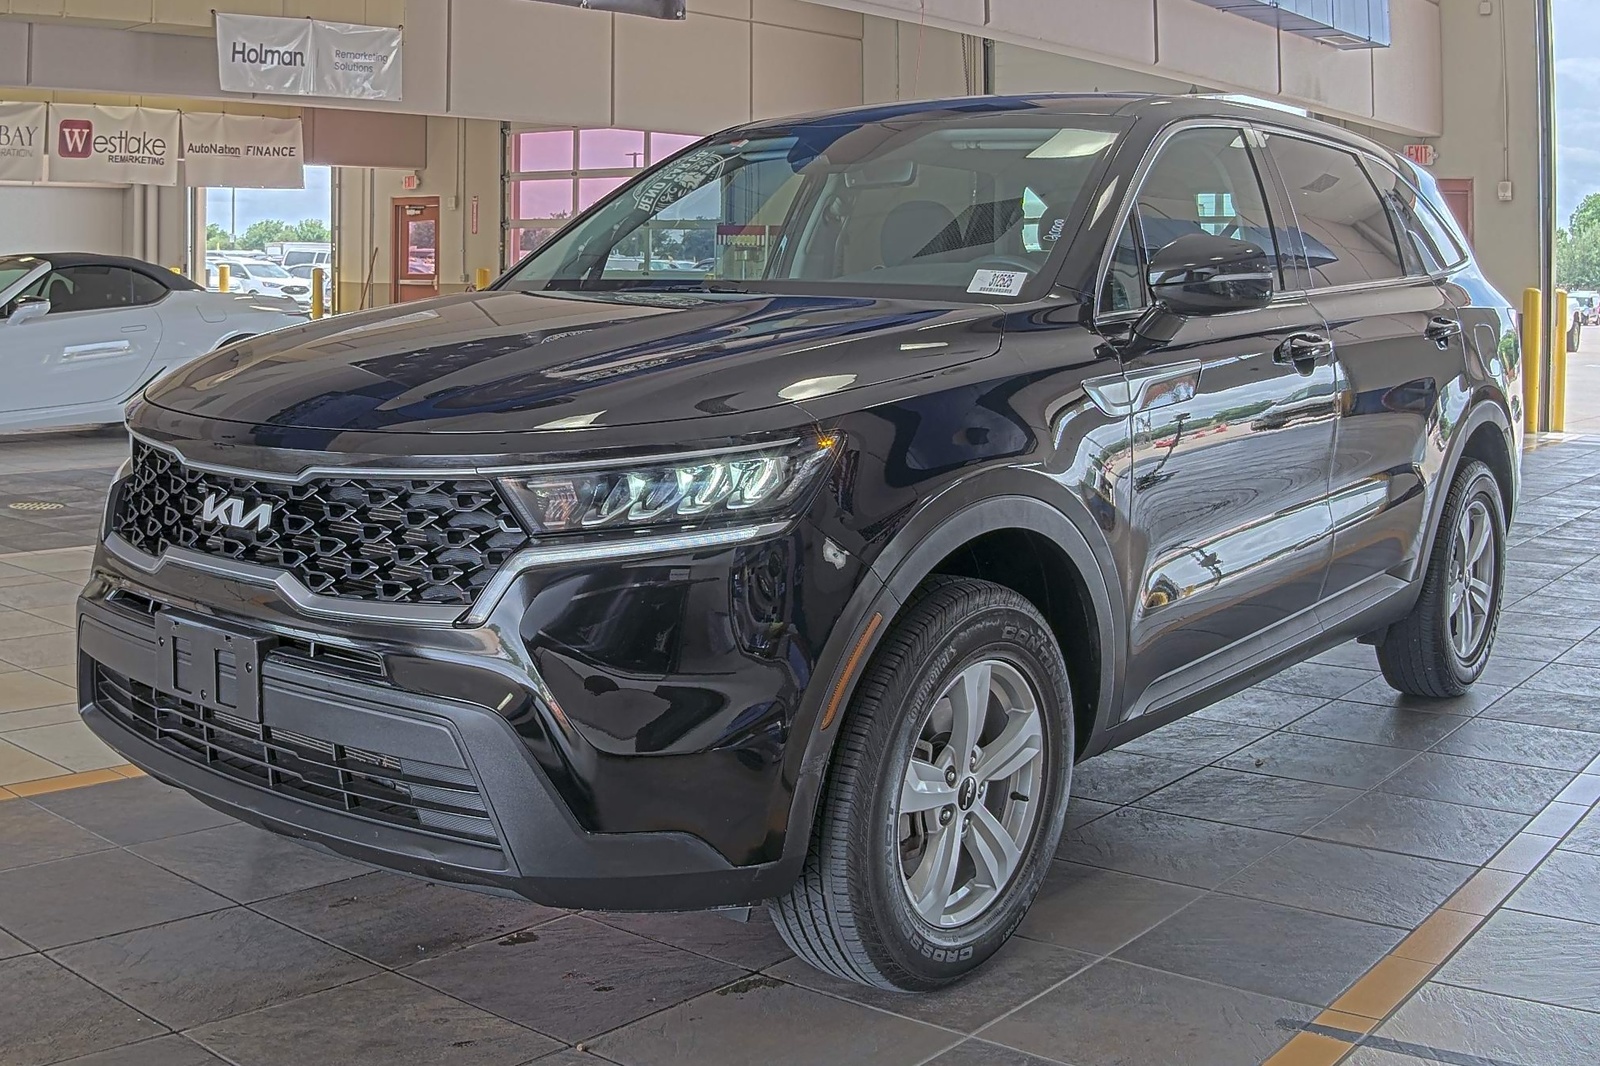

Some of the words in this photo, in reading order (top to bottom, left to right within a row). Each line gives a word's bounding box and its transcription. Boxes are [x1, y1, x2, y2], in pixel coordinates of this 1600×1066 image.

[231, 41, 305, 67] Holman
[335, 49, 389, 64] Remarketing
[334, 61, 374, 73] Solutions
[0, 124, 39, 146] BAY
[62, 127, 167, 156] Westlake
[187, 142, 241, 156] AutoNation
[246, 145, 296, 157] FINANCE
[1408, 146, 1428, 163] EXIT
[107, 154, 165, 166] REMARKETING
